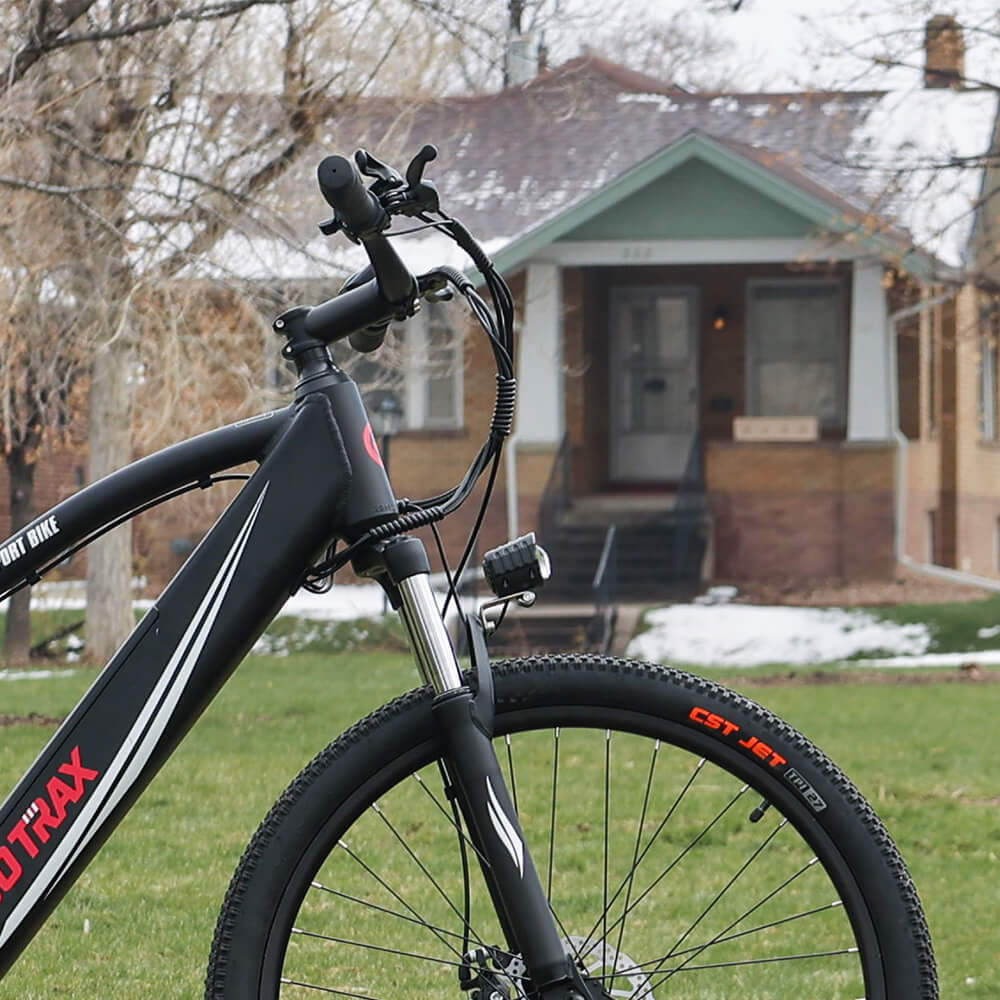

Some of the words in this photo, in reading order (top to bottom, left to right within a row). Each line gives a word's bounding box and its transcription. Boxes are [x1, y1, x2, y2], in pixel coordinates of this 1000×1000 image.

[25, 514, 61, 549] BIKE
[688, 706, 741, 736] CST
[738, 735, 788, 768] JET
[807, 791, 824, 810] 27
